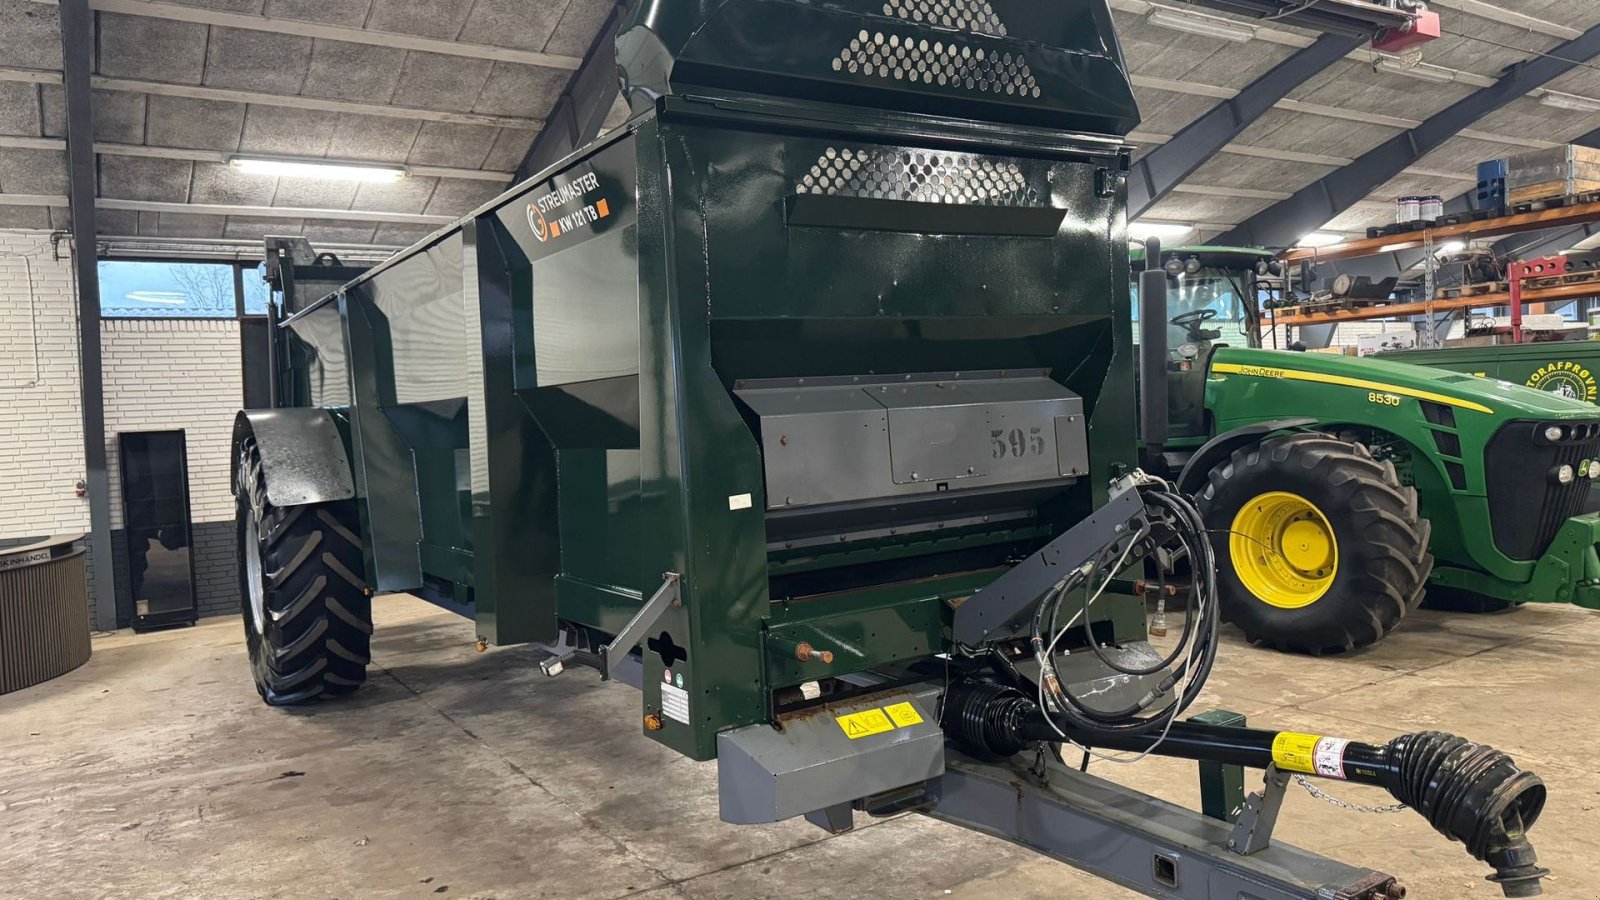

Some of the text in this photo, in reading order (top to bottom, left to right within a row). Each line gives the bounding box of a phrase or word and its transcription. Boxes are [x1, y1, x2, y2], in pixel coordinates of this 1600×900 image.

[537, 172, 600, 213] STREUMASTER
[558, 205, 598, 234] KW 121 TB
[1237, 366, 1285, 379] JOHN DEERE
[1368, 392, 1401, 406] 8530
[990, 426, 1045, 460] 595
